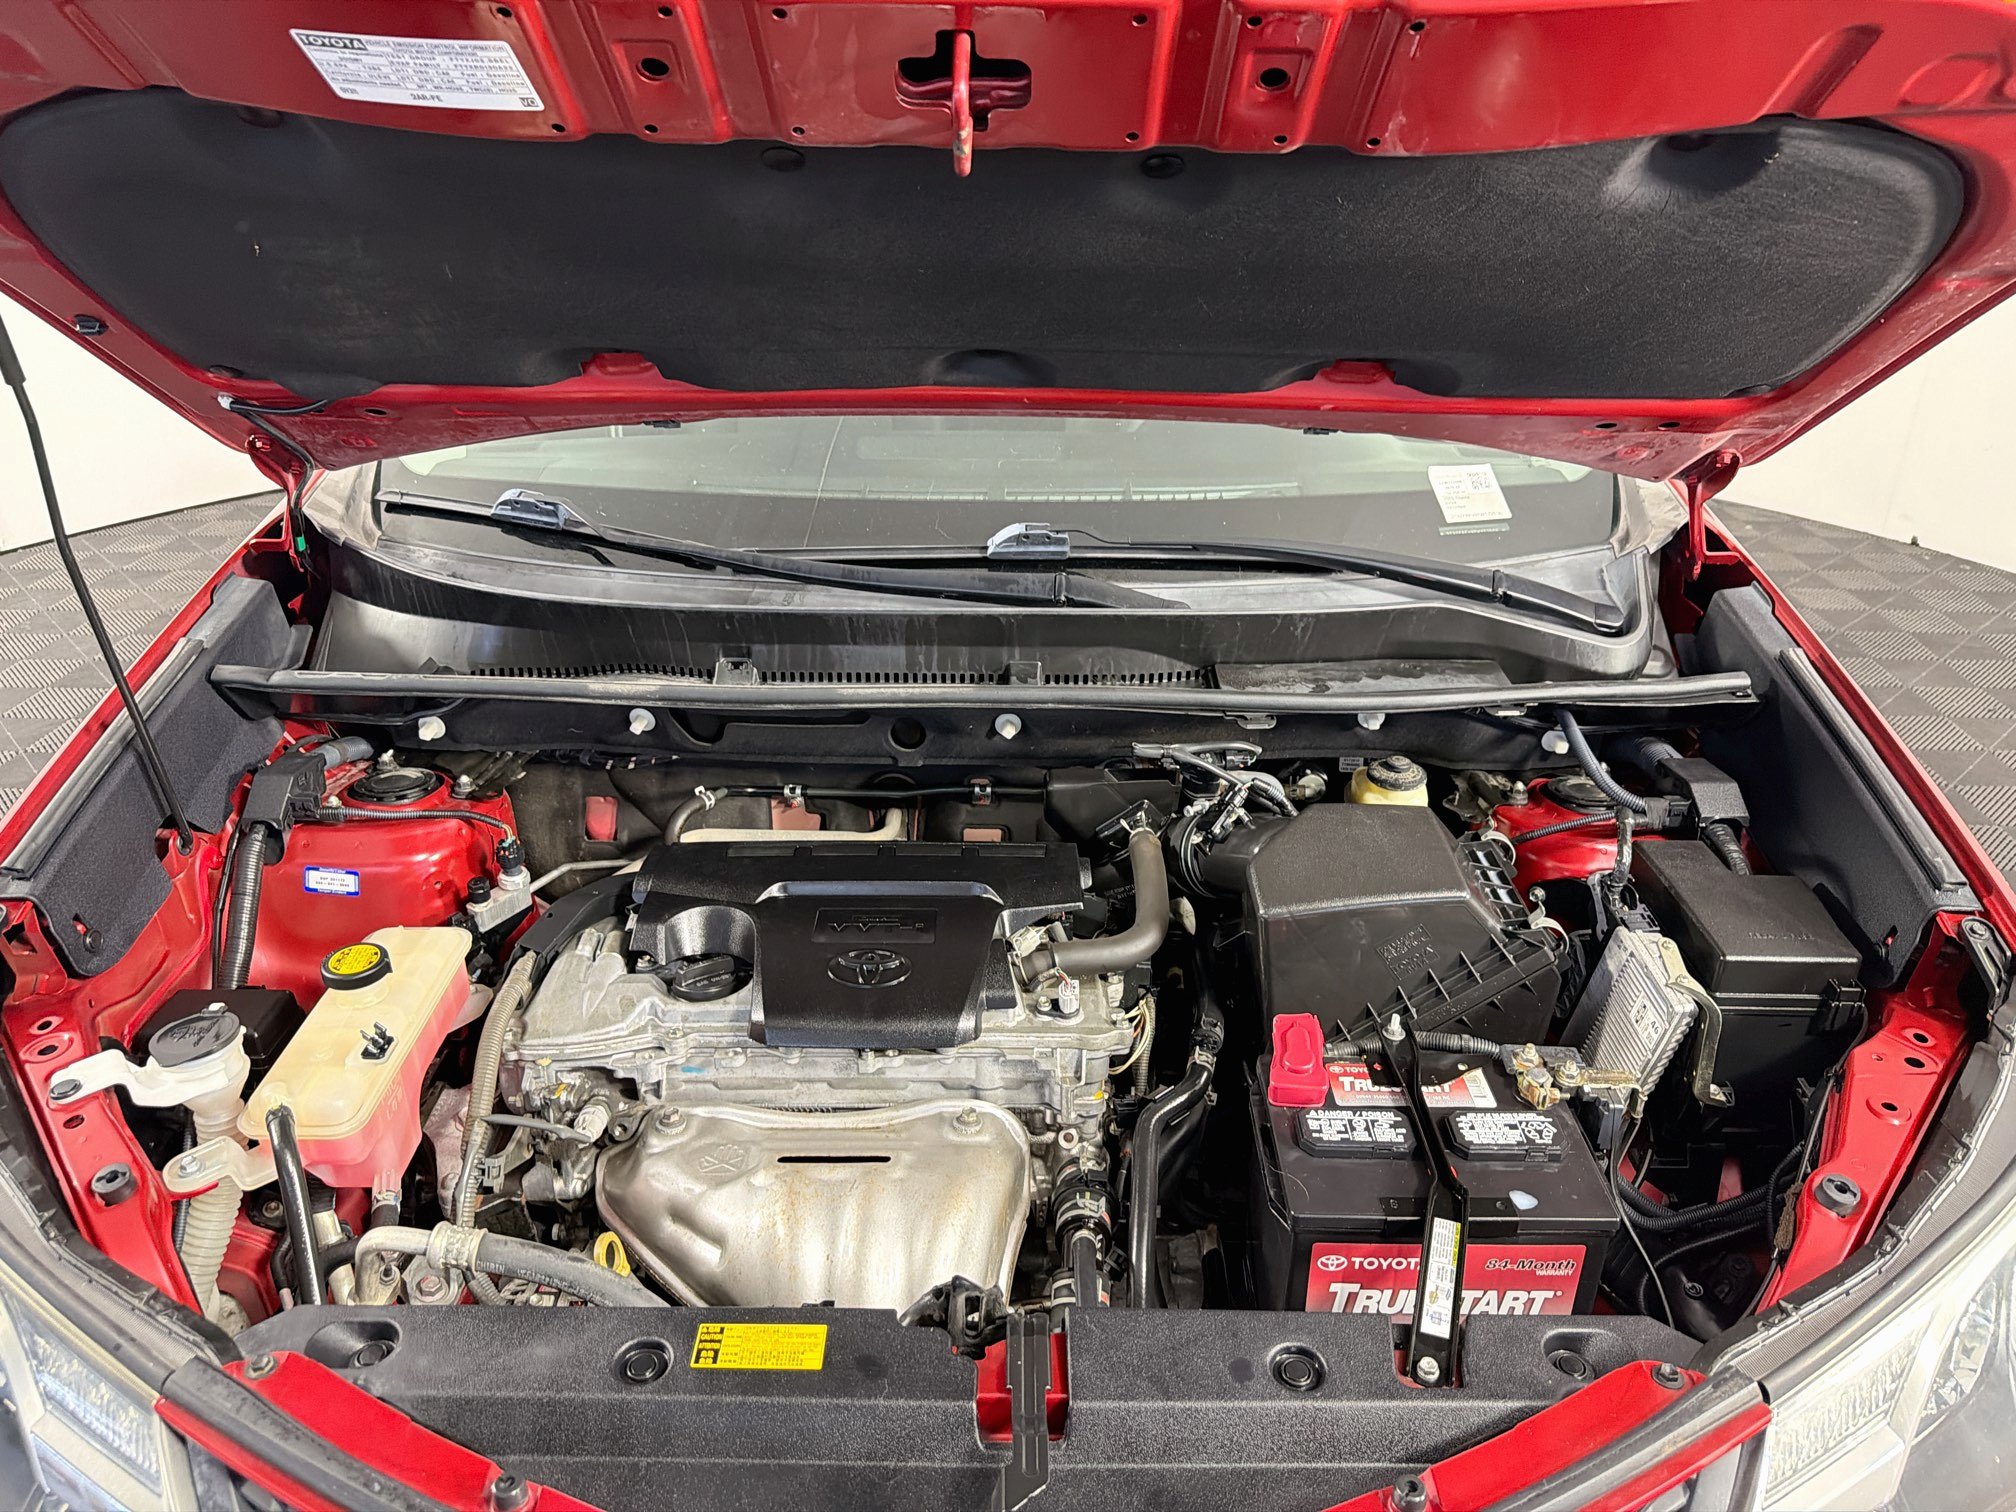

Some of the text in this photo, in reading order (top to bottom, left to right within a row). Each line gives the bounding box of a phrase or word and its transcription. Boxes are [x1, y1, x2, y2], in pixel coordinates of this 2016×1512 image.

[300, 34, 365, 50] TOYOTA
[1345, 1066, 1369, 1074] TOYO
[1317, 1110, 1354, 1118] DANGER
[1361, 1111, 1395, 1119] POISON
[1351, 1257, 1420, 1270] TOYOT
[1485, 1259, 1577, 1271] 84-Month
